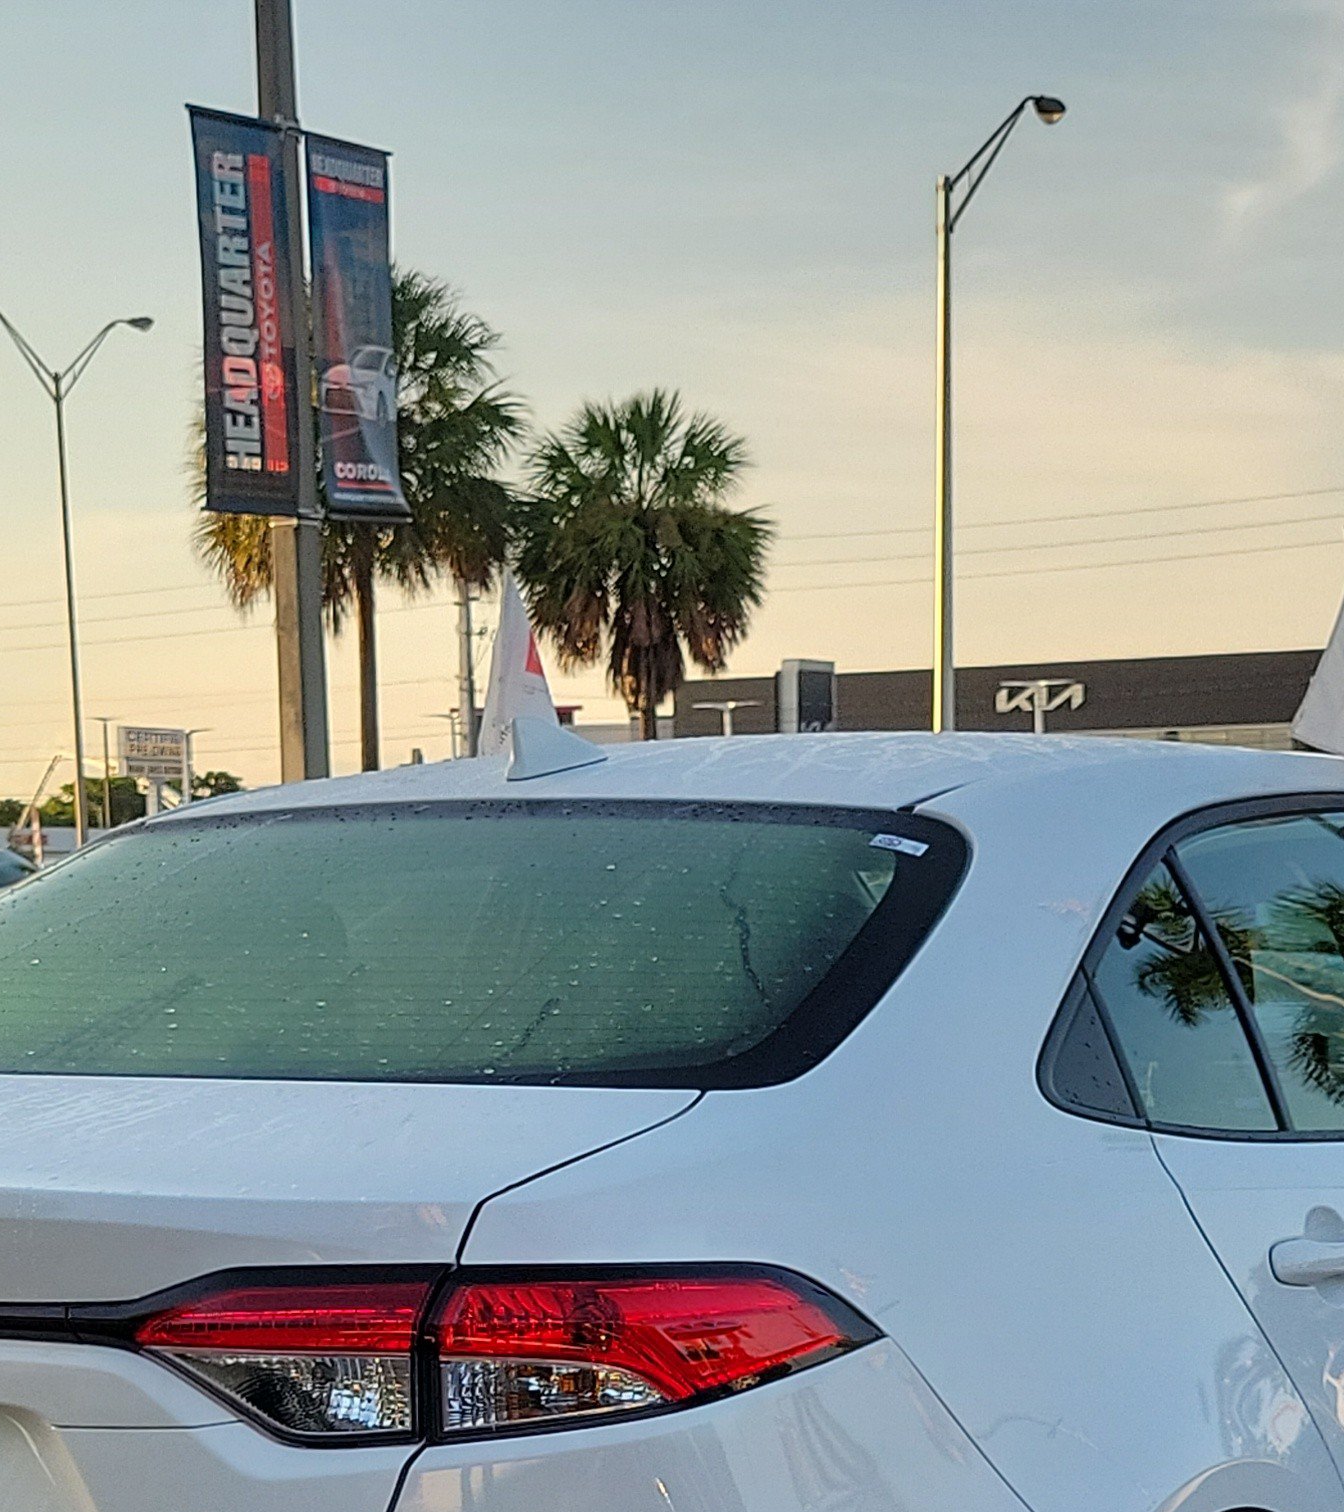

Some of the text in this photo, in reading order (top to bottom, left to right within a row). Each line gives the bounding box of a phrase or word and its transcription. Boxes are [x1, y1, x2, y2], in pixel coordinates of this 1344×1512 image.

[213, 152, 262, 471] HEADQUARTER
[257, 242, 281, 363] TOYOTA
[995, 683, 1085, 714] KIA
